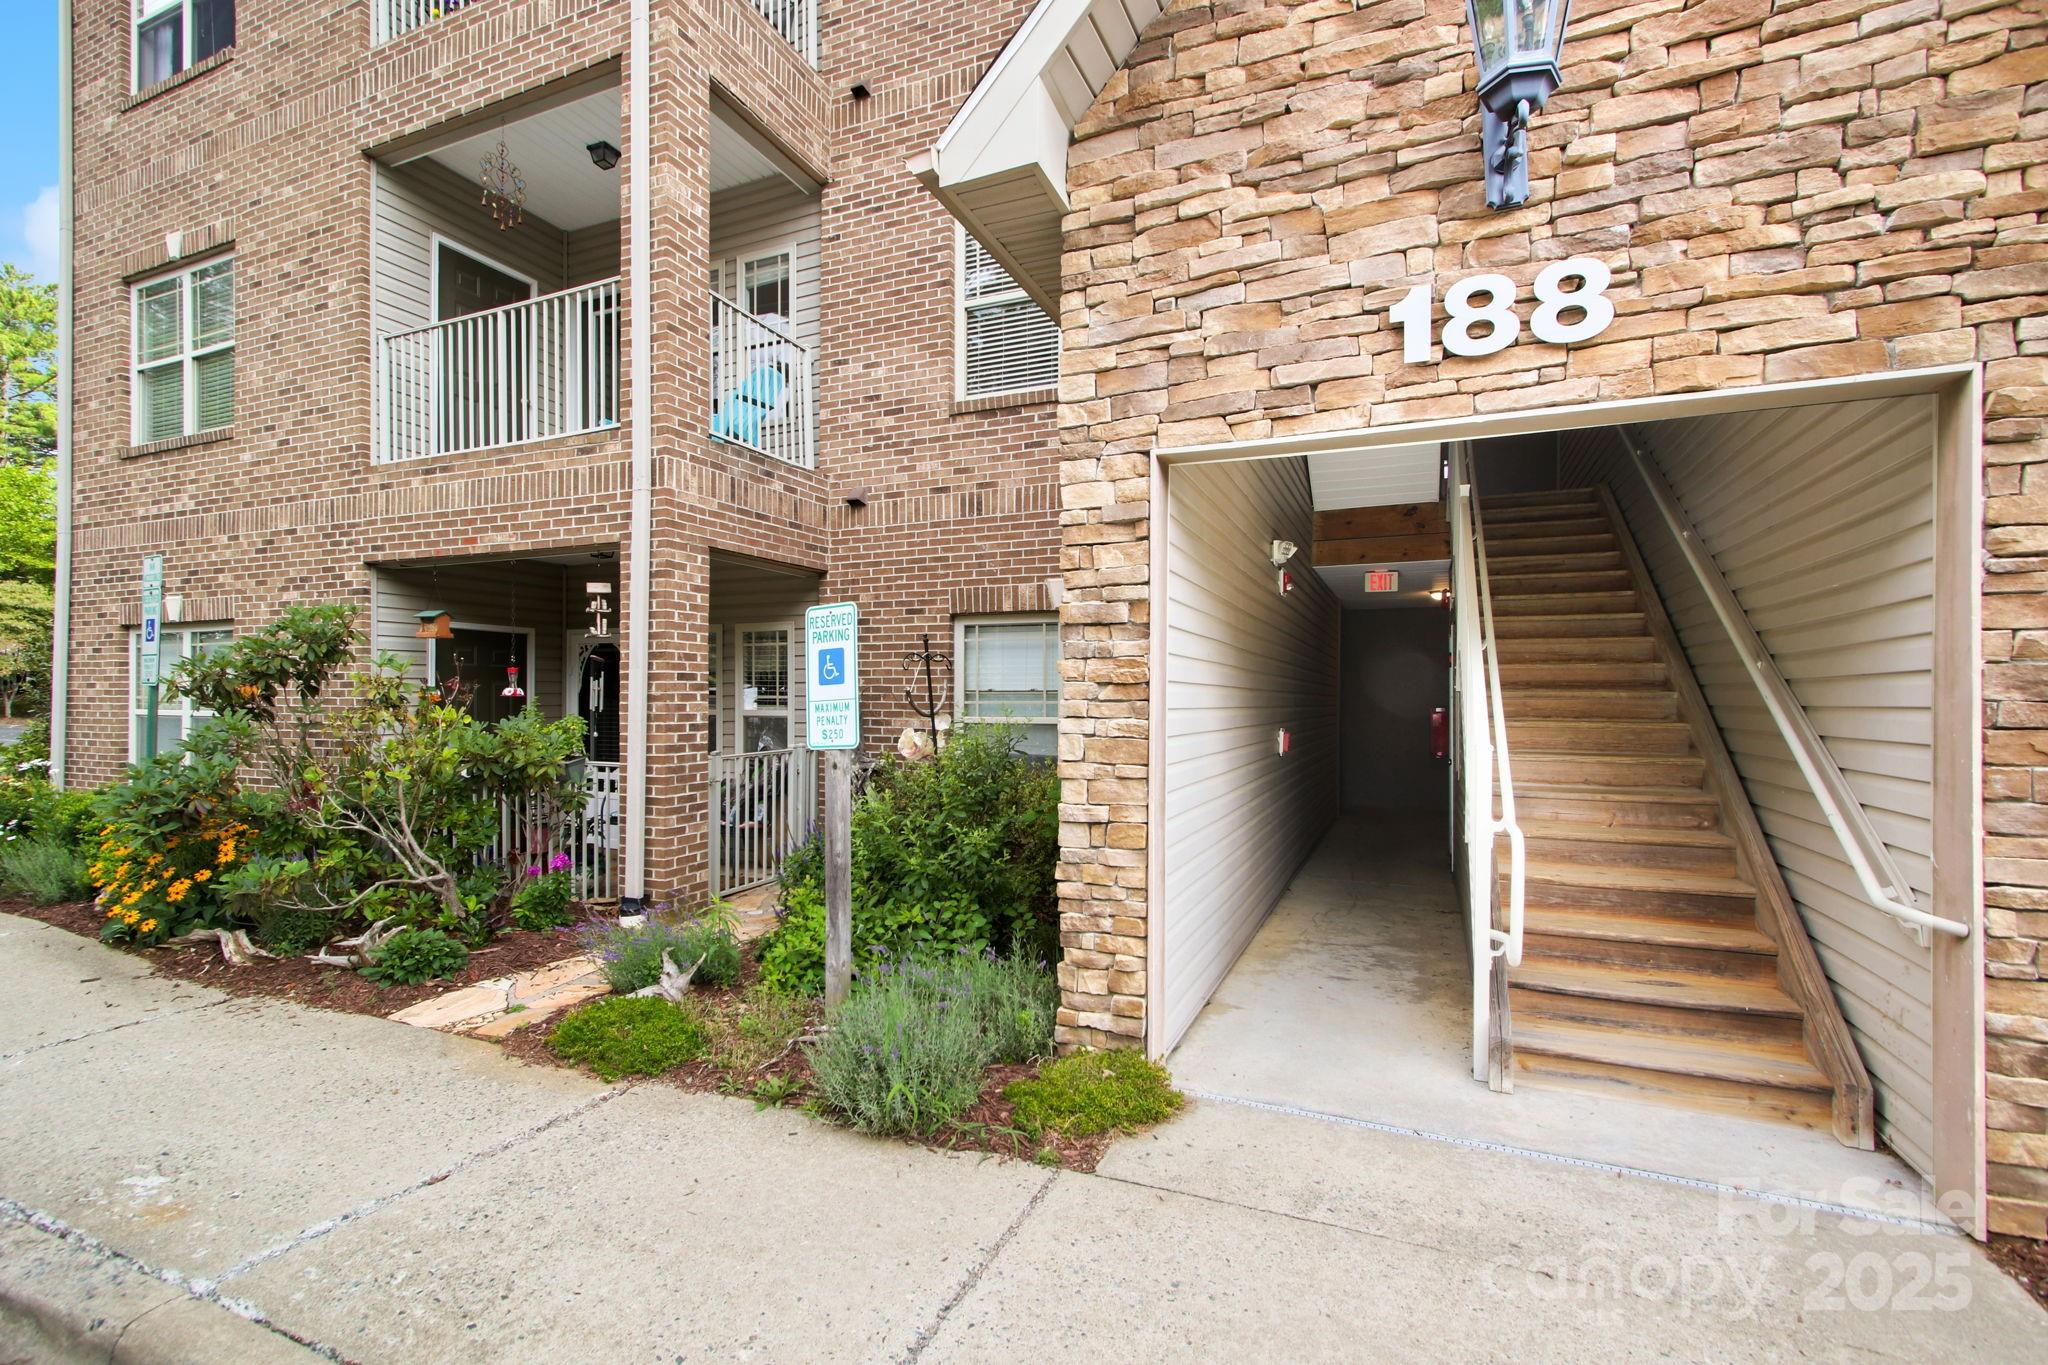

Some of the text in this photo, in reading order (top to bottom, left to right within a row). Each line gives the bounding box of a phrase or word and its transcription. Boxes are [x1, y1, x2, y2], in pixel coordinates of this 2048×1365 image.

[1389, 257, 1615, 364] 188
[1368, 573, 1393, 592] EXIT
[809, 612, 853, 629] RESERVED
[812, 628, 850, 644] PARKING
[815, 701, 850, 713] MAXIMUM
[816, 714, 848, 727] PENALTY
